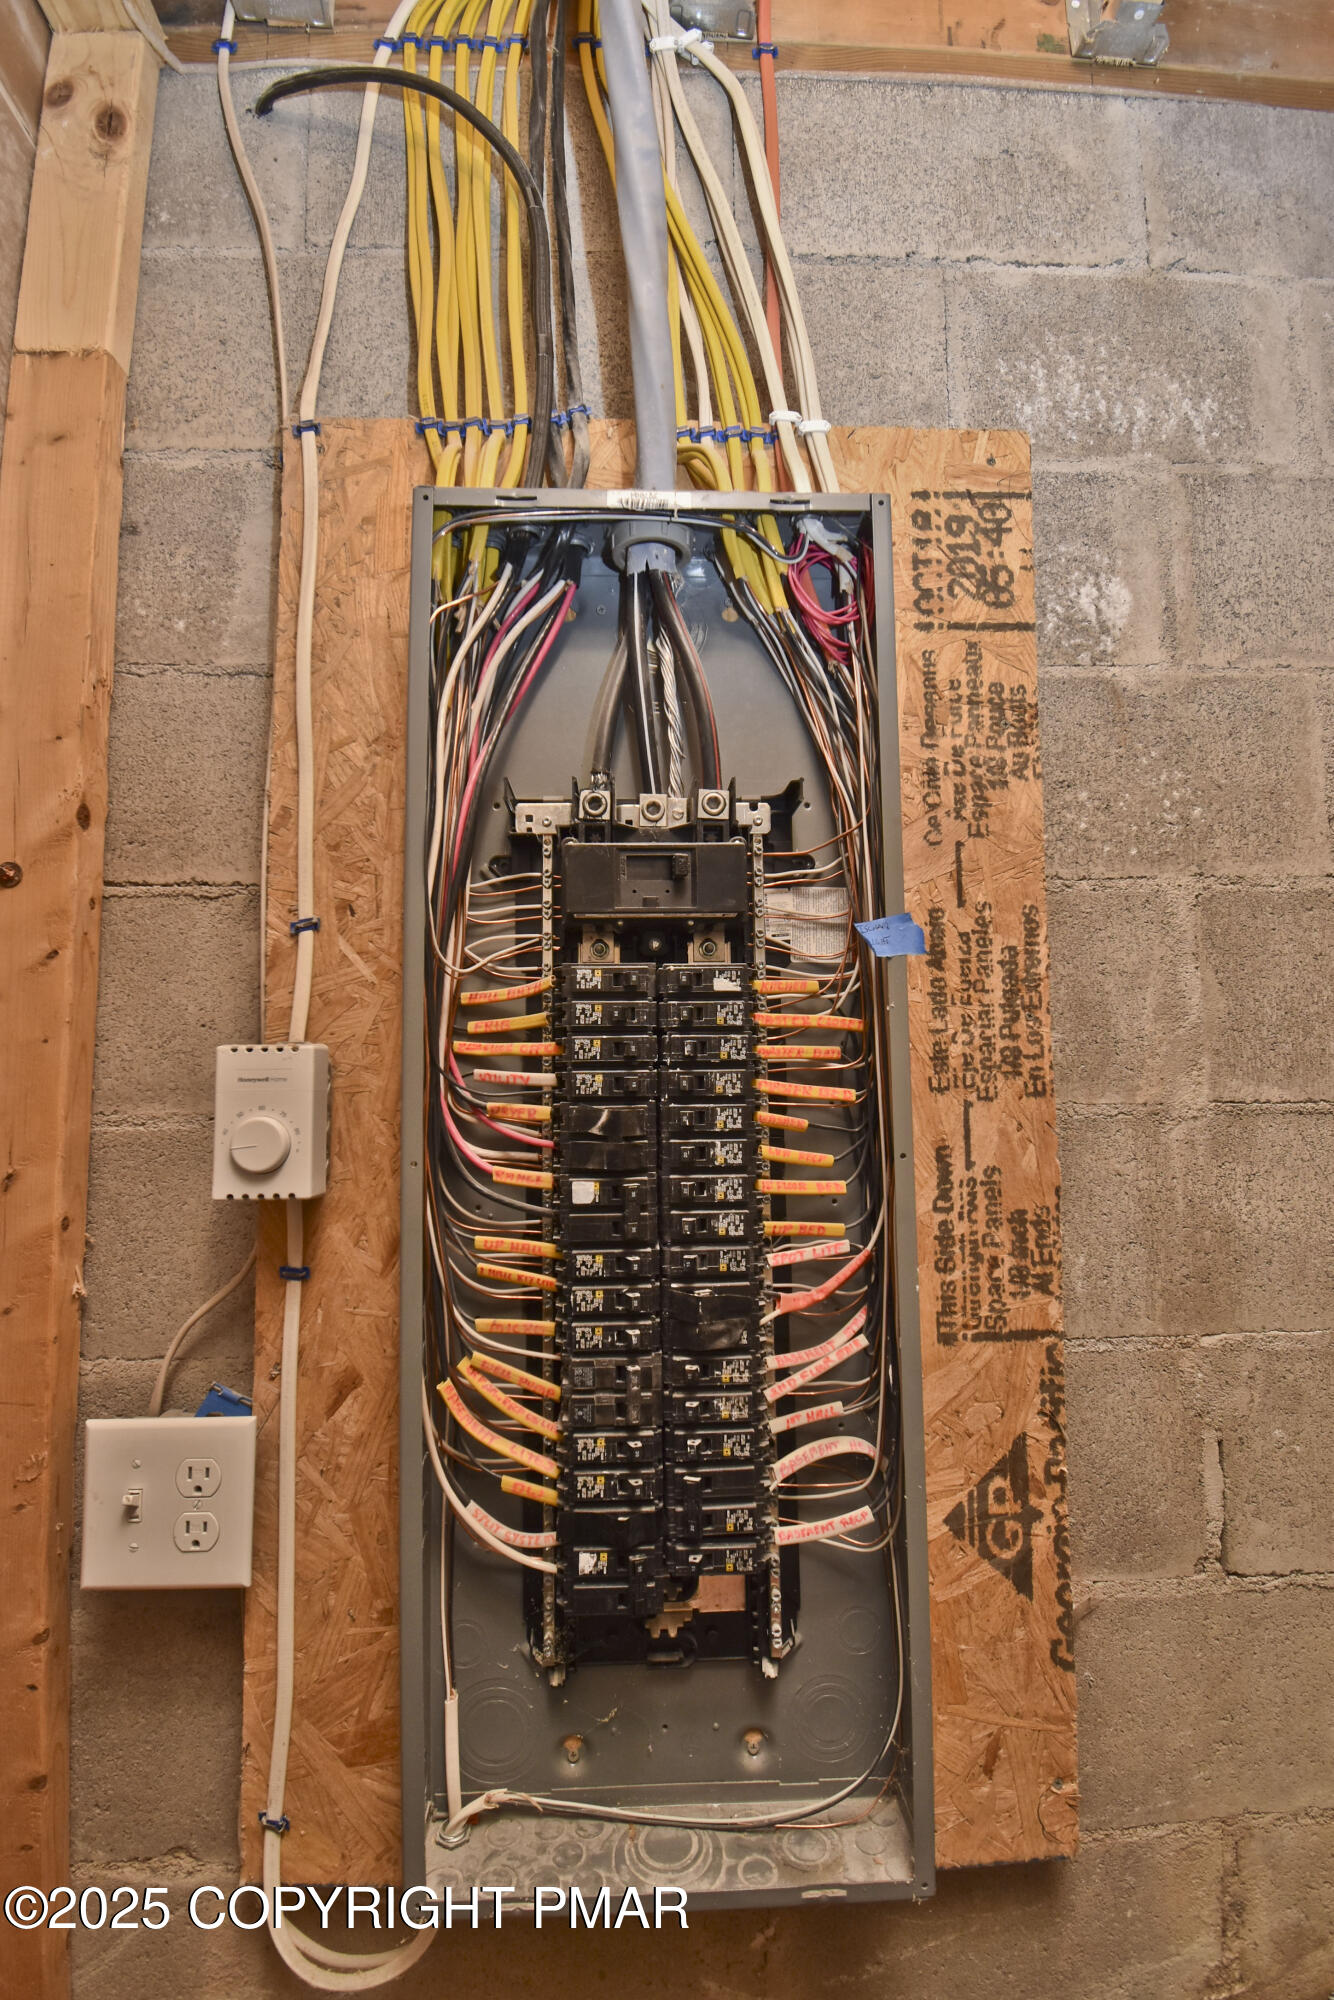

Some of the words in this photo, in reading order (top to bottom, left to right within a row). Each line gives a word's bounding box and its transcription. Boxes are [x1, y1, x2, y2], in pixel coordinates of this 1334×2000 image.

[944, 515, 980, 600] 2019
[972, 901, 993, 994] Paneles
[926, 977, 949, 1034] Lado
[997, 945, 1020, 1042] Pulgada
[478, 1072, 531, 1085] UTILITY
[927, 1041, 950, 1094] Este
[1023, 1066, 1046, 1099] En
[932, 1145, 955, 1214] Down
[771, 1224, 793, 1234] UP
[798, 1225, 826, 1235] BED
[979, 1165, 1003, 1248] Panels
[483, 1239, 505, 1250] UP
[510, 1241, 543, 1254] HALL
[771, 1250, 807, 1266] SPOT
[812, 1242, 846, 1257] LITE
[933, 1219, 956, 1275] Side
[935, 1281, 957, 1337] This
[775, 1340, 835, 1368] BASEMENT
[806, 1406, 841, 1423] HALL
[779, 1440, 840, 1478] BASEMENT
[472, 1507, 503, 1534] SPLIT
[504, 1530, 556, 1546] SYSTEM
[778, 1522, 836, 1542] BASEMENT
[984, 1474, 1023, 1560] GP
